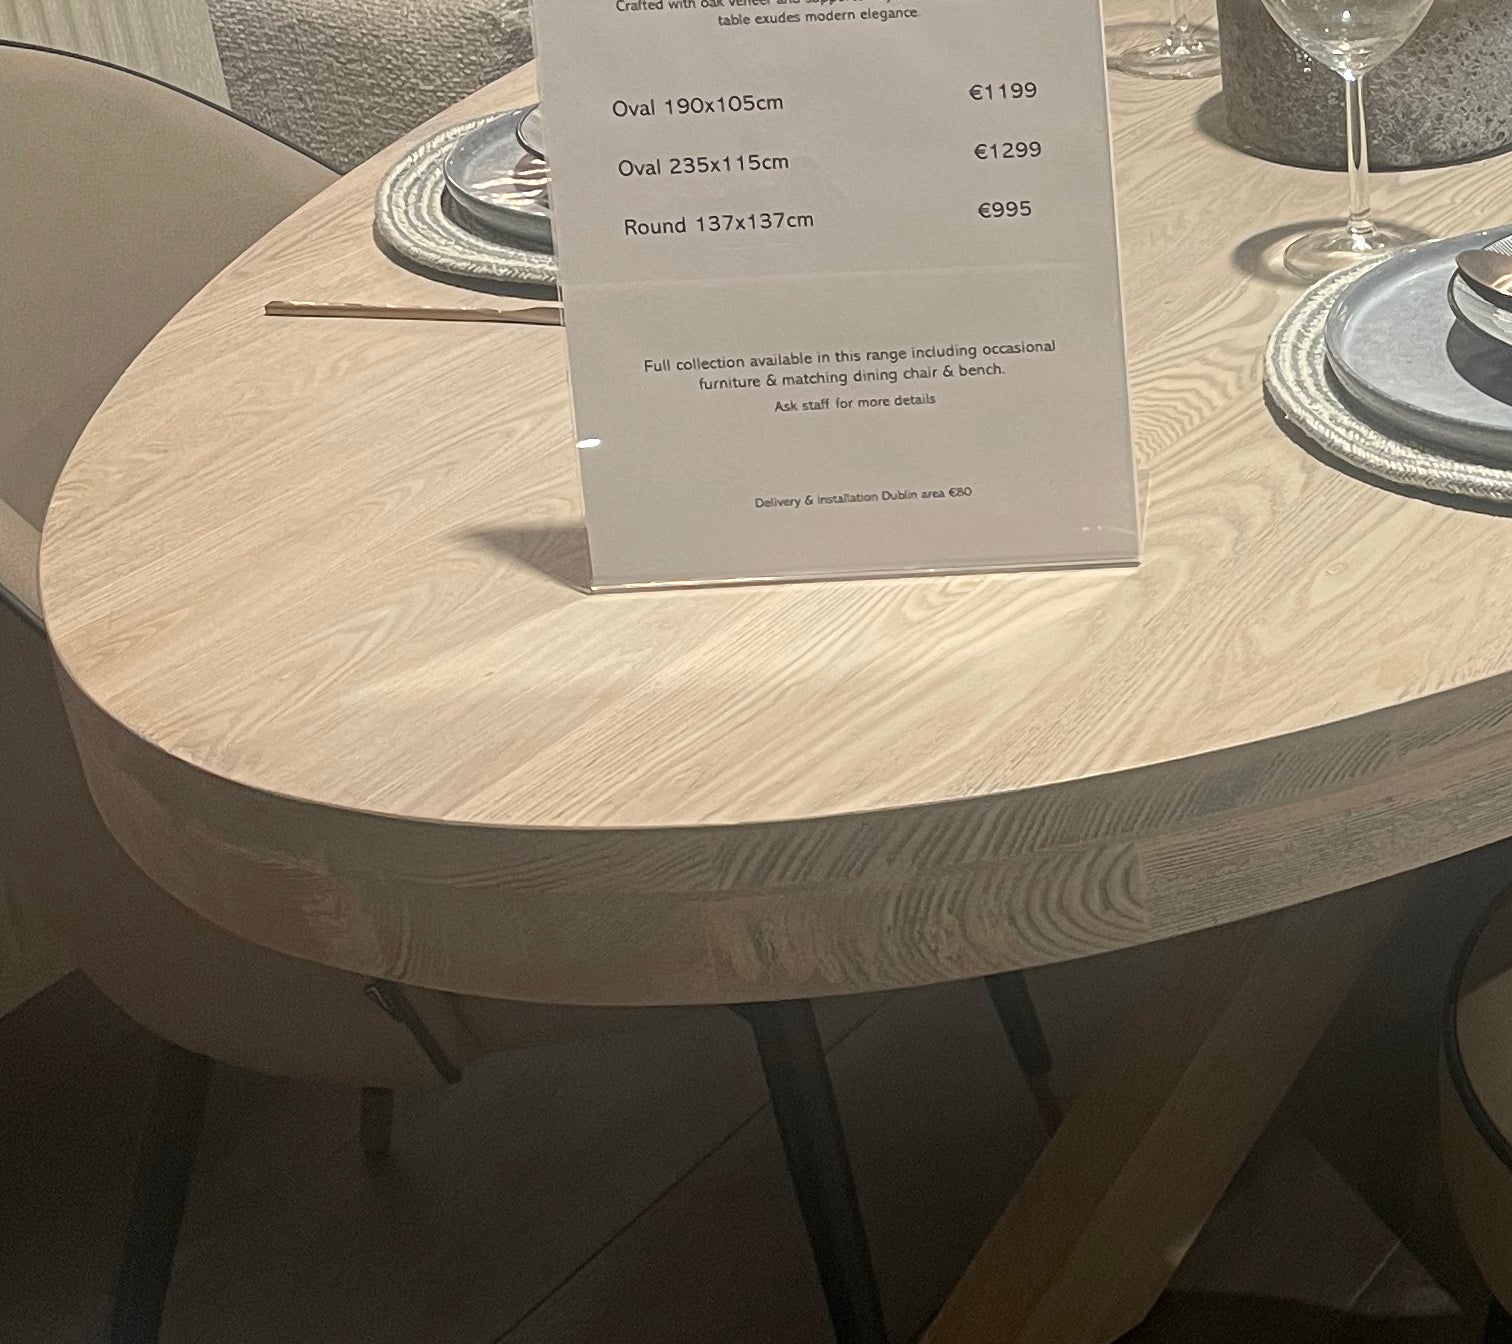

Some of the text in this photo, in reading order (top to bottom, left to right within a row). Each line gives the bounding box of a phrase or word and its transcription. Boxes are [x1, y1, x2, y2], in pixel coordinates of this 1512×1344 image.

[717, 13, 751, 27] table
[754, 11, 801, 25] exudes
[804, 9, 856, 22] modern
[612, 81, 1037, 118] Oval 190x105cm €1199
[618, 140, 1042, 177] Oval 235x115cm €1299
[624, 200, 1032, 236] Round 137x137cm €995
[644, 339, 1056, 373] Full collection available in this range including occasional
[698, 377, 761, 390] furniture
[765, 373, 777, 387] &
[782, 370, 848, 387] matching
[852, 369, 898, 384] dining
[902, 365, 938, 380] chair
[942, 364, 954, 378] &
[774, 392, 937, 413] Ask staff for more details
[754, 486, 973, 509] Delivery & installation Dublin area €80
